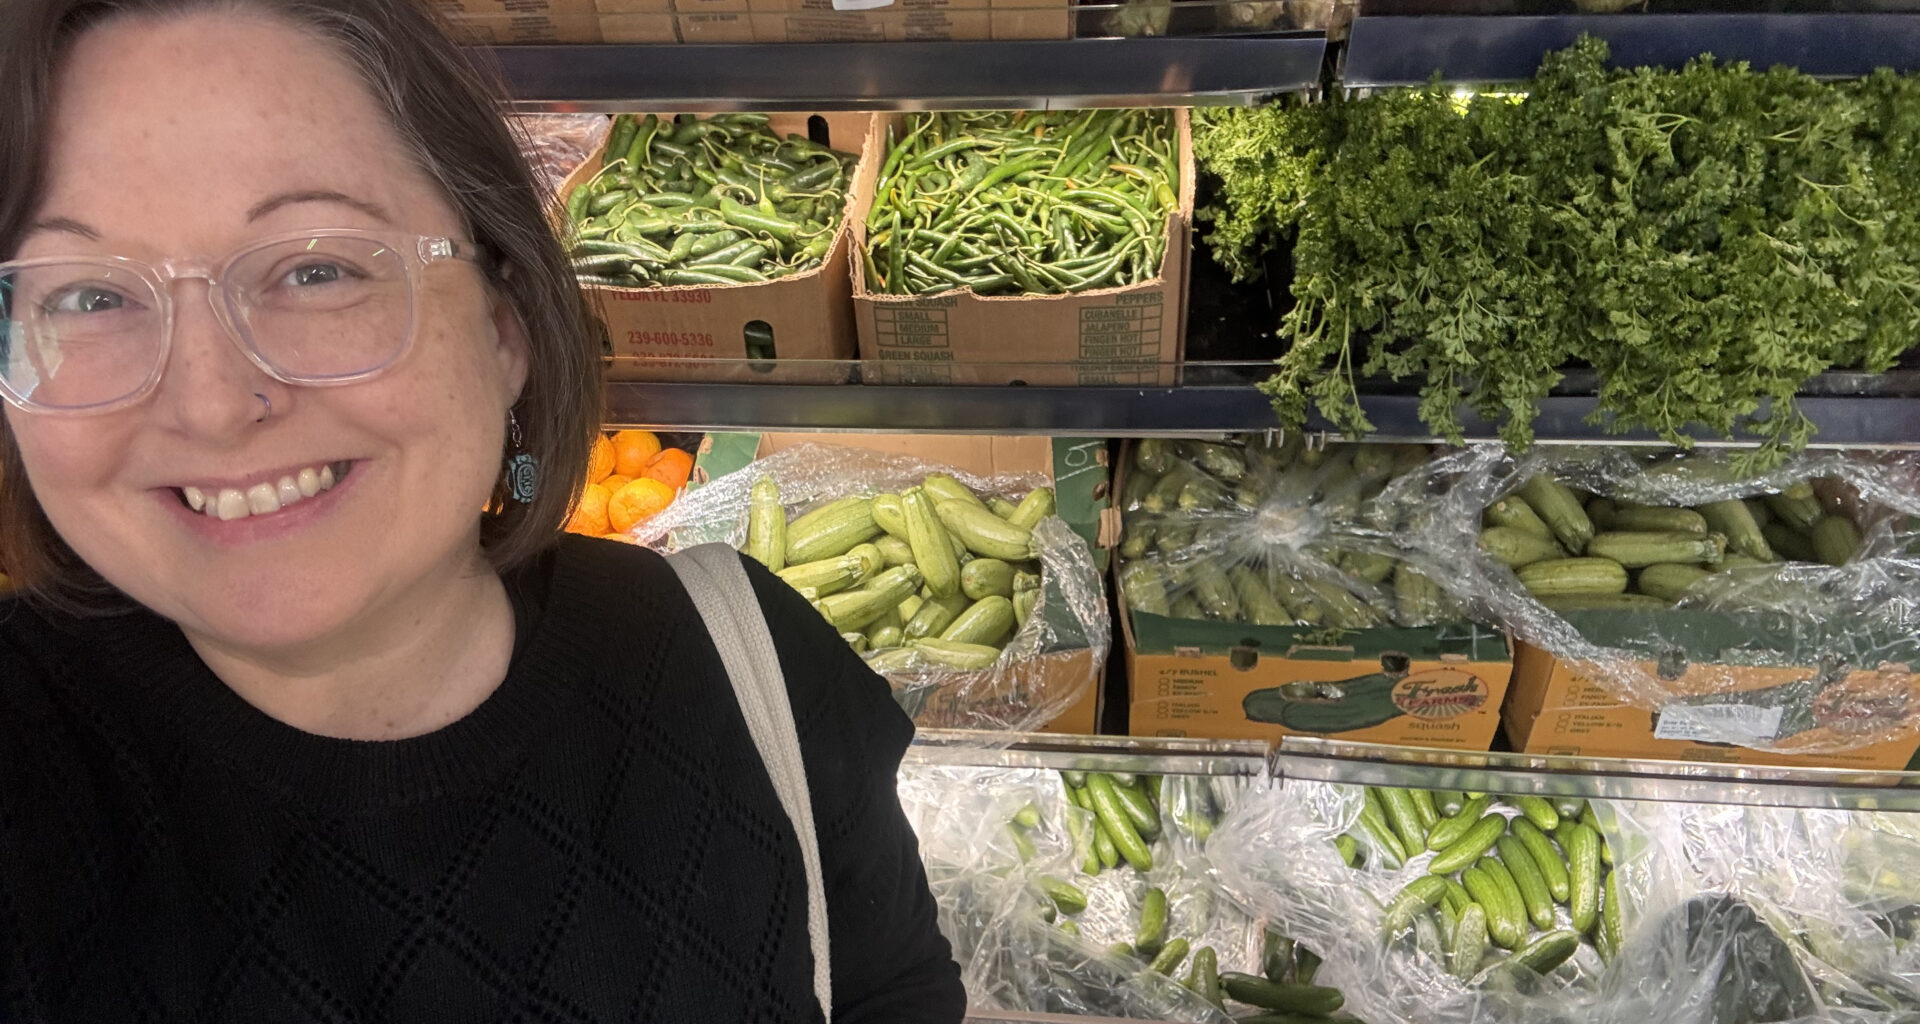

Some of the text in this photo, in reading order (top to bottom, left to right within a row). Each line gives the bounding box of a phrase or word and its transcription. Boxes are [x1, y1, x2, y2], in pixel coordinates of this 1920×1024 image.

[653, 291, 668, 303] FL
[671, 290, 712, 304] 33930
[1115, 291, 1164, 304] PEPPERS
[898, 312, 931, 321] SMALL
[1084, 309, 1138, 320] CUBANELLE
[899, 324, 940, 333] MEDIUM
[628, 331, 713, 347] 239-600-5336
[901, 335, 932, 345] LARGE
[1084, 333, 1139, 345] FINGER HOT
[878, 350, 954, 361] GREEN SQUASH
[1119, 346, 1138, 357] HOT
[1407, 721, 1461, 731] squash
